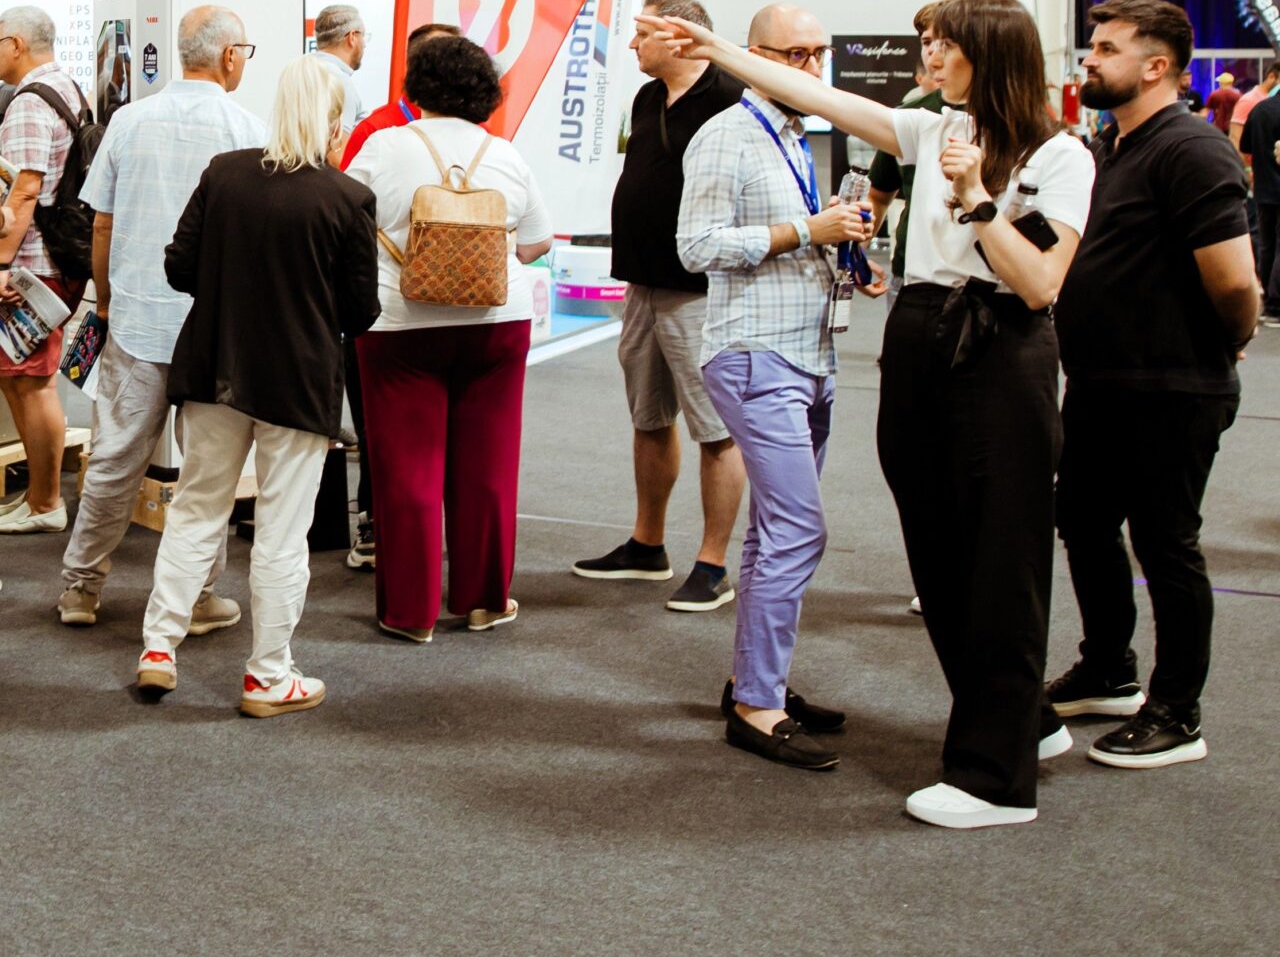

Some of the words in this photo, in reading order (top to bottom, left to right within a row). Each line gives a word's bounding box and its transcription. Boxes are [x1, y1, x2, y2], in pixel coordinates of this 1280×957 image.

[69, 4, 91, 15] EPS
[69, 20, 93, 30] XPS
[60, 51, 83, 62] GEO
